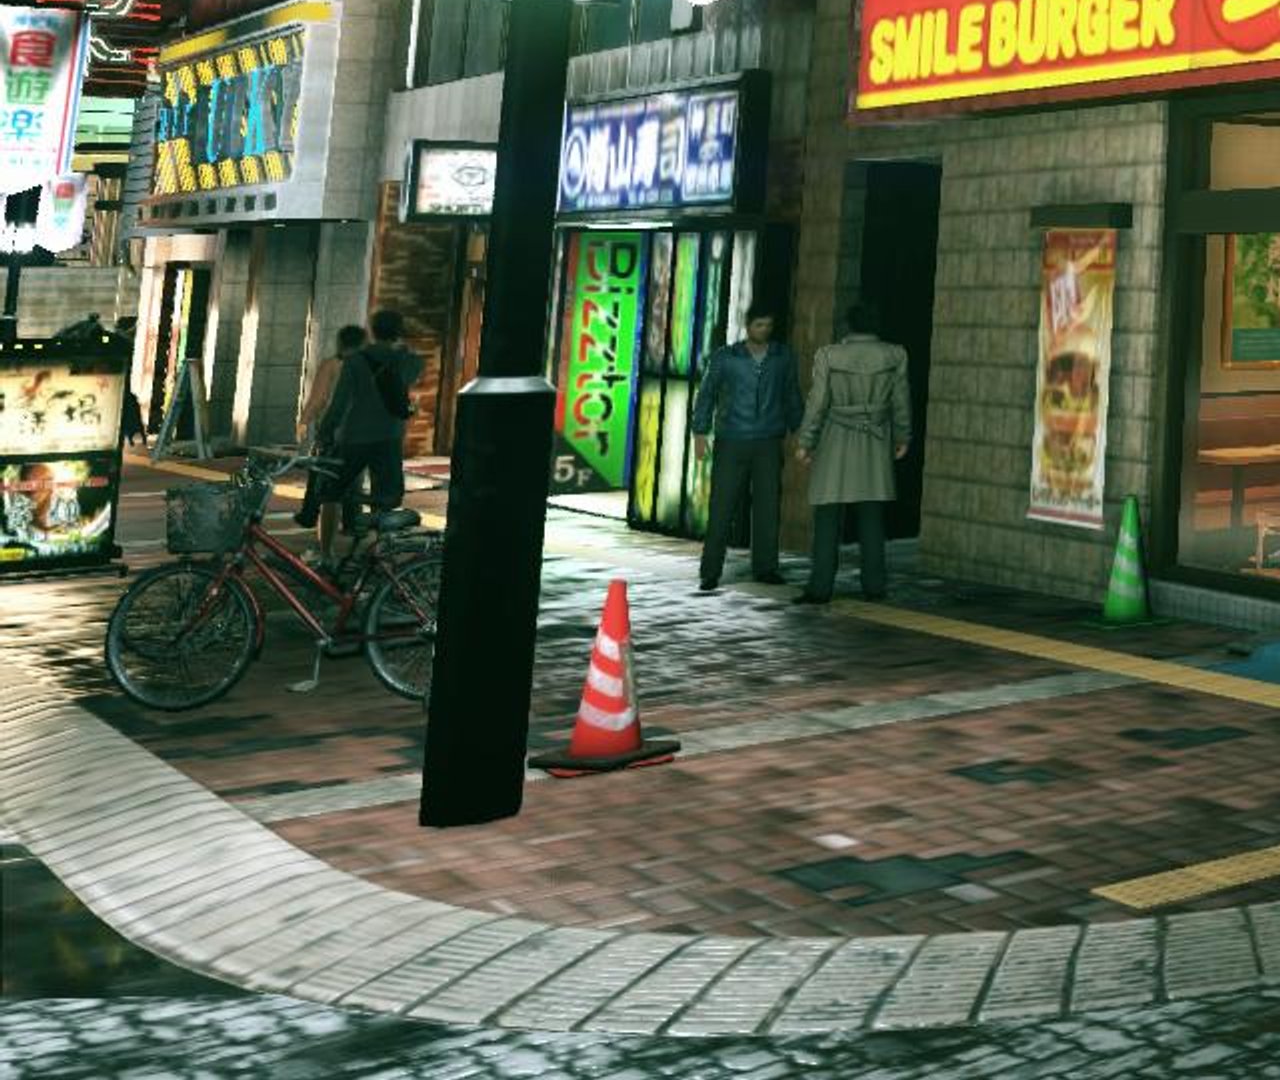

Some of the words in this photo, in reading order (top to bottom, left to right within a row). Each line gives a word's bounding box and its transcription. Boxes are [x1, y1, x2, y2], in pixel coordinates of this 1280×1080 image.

[869, 0, 984, 85] SMILE
[571, 240, 638, 458] Bizztor
[551, 453, 593, 488] 5F
